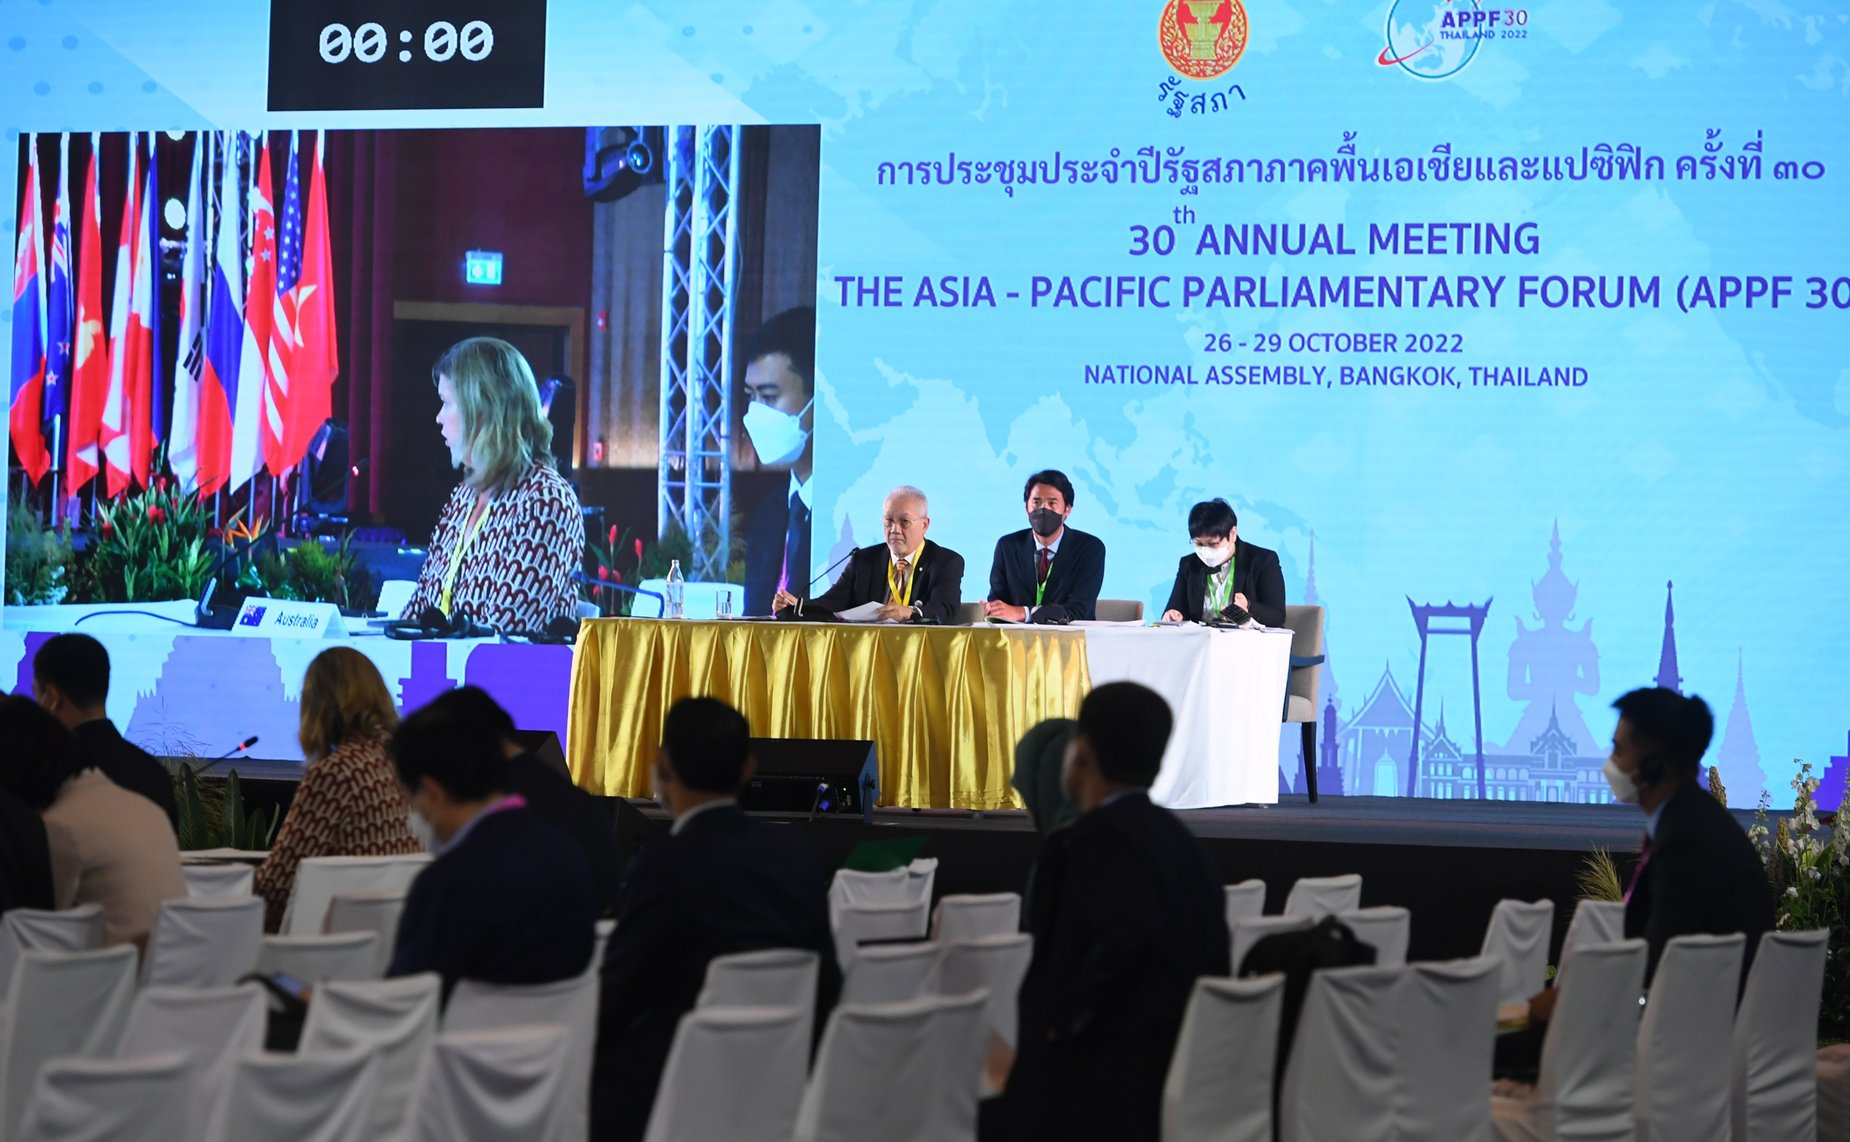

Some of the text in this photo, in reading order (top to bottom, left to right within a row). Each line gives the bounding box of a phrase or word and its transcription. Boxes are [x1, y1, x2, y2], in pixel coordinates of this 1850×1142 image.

[319, 20, 494, 64] 00:00
[1440, 30, 1527, 39] THAILAND 2022
[1158, 75, 1246, 119] รัฐสภา
[877, 128, 1826, 198] การประชุมประจำปีรัฐสภาภาคพื้นเอเชียและแปซิฟิก ครั้งที่ ๓๐
[1196, 223, 1356, 256] ANNUAL
[1368, 221, 1540, 255] MEETING
[834, 275, 903, 308] THE
[913, 275, 997, 308] ASIA
[1031, 275, 1171, 308] PACIFIC
[1183, 275, 1507, 308] PARLIAMENTARY
[1518, 275, 1660, 309] FORUM
[1676, 275, 1793, 314] (APPF
[1204, 333, 1232, 353] 26
[1253, 333, 1282, 353] 29
[1288, 332, 1398, 353] OCTOBER
[1404, 333, 1463, 353] 2022
[1084, 364, 1588, 390] NATIONAL ASSEMBLY, BANGKOK, THAILAND
[274, 611, 319, 629] Australia
